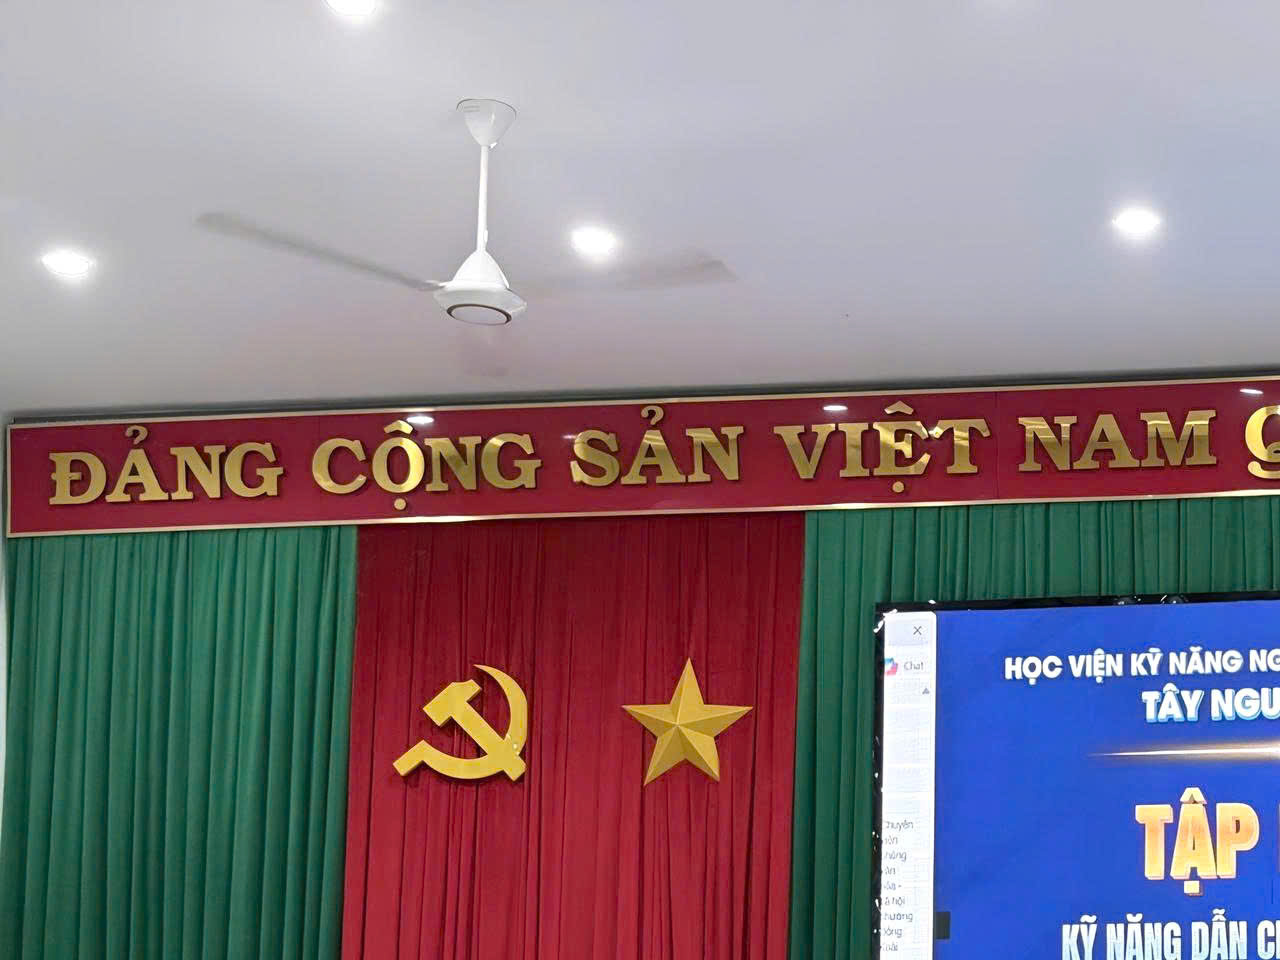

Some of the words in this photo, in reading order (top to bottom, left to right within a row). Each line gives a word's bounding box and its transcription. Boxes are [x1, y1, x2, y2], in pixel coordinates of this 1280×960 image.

[50, 425, 283, 506] ĐẢNG
[312, 420, 543, 510] CỘNG
[570, 405, 747, 488] SẢN
[775, 401, 991, 493] VIỆT
[1018, 410, 1217, 473] NAM
[1004, 655, 1063, 685] HỌC
[1068, 648, 1123, 684] VIỆN
[1130, 648, 1163, 676] KỸ
[1169, 646, 1243, 676] NĂNG
[1142, 683, 1204, 723] TÂY
[1135, 787, 1260, 896] TẬP
[1191, 908, 1248, 960] DẪN
